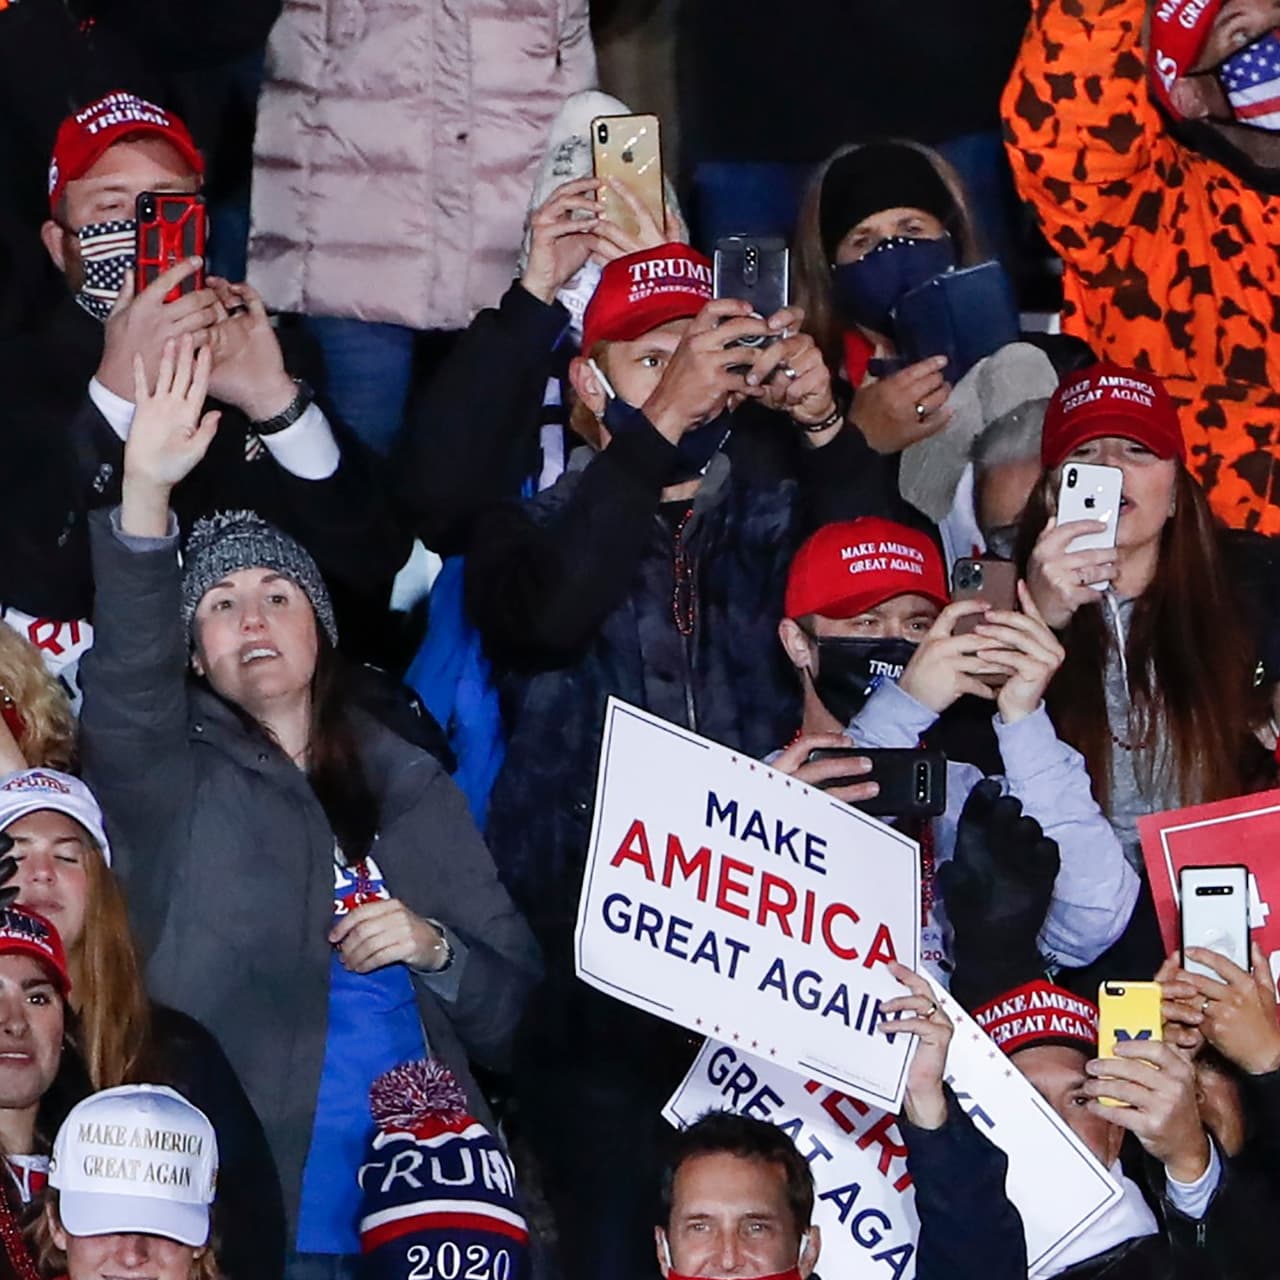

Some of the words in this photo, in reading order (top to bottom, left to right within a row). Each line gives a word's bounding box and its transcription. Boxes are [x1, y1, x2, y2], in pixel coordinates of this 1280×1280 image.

[1098, 375, 1156, 398] AMERICA
[1109, 388, 1154, 408] AGAIN
[841, 545, 868, 561] MAKE
[868, 542, 924, 563] AMERICA
[849, 557, 889, 574] GREAT
[889, 559, 923, 575] AGAIN
[869, 660, 903, 680] TRU
[705, 790, 828, 876] MAKE
[608, 818, 899, 972] AMERICA
[601, 893, 752, 982] GREAT
[757, 957, 900, 1046] AGAIN
[976, 994, 1026, 1027] MAKE
[988, 1013, 1047, 1046] GREAT
[80, 1122, 127, 1147] MAKE
[83, 1155, 139, 1181] GREAT
[142, 1161, 192, 1188] AGAIN
[357, 1147, 516, 1198] TRUM
